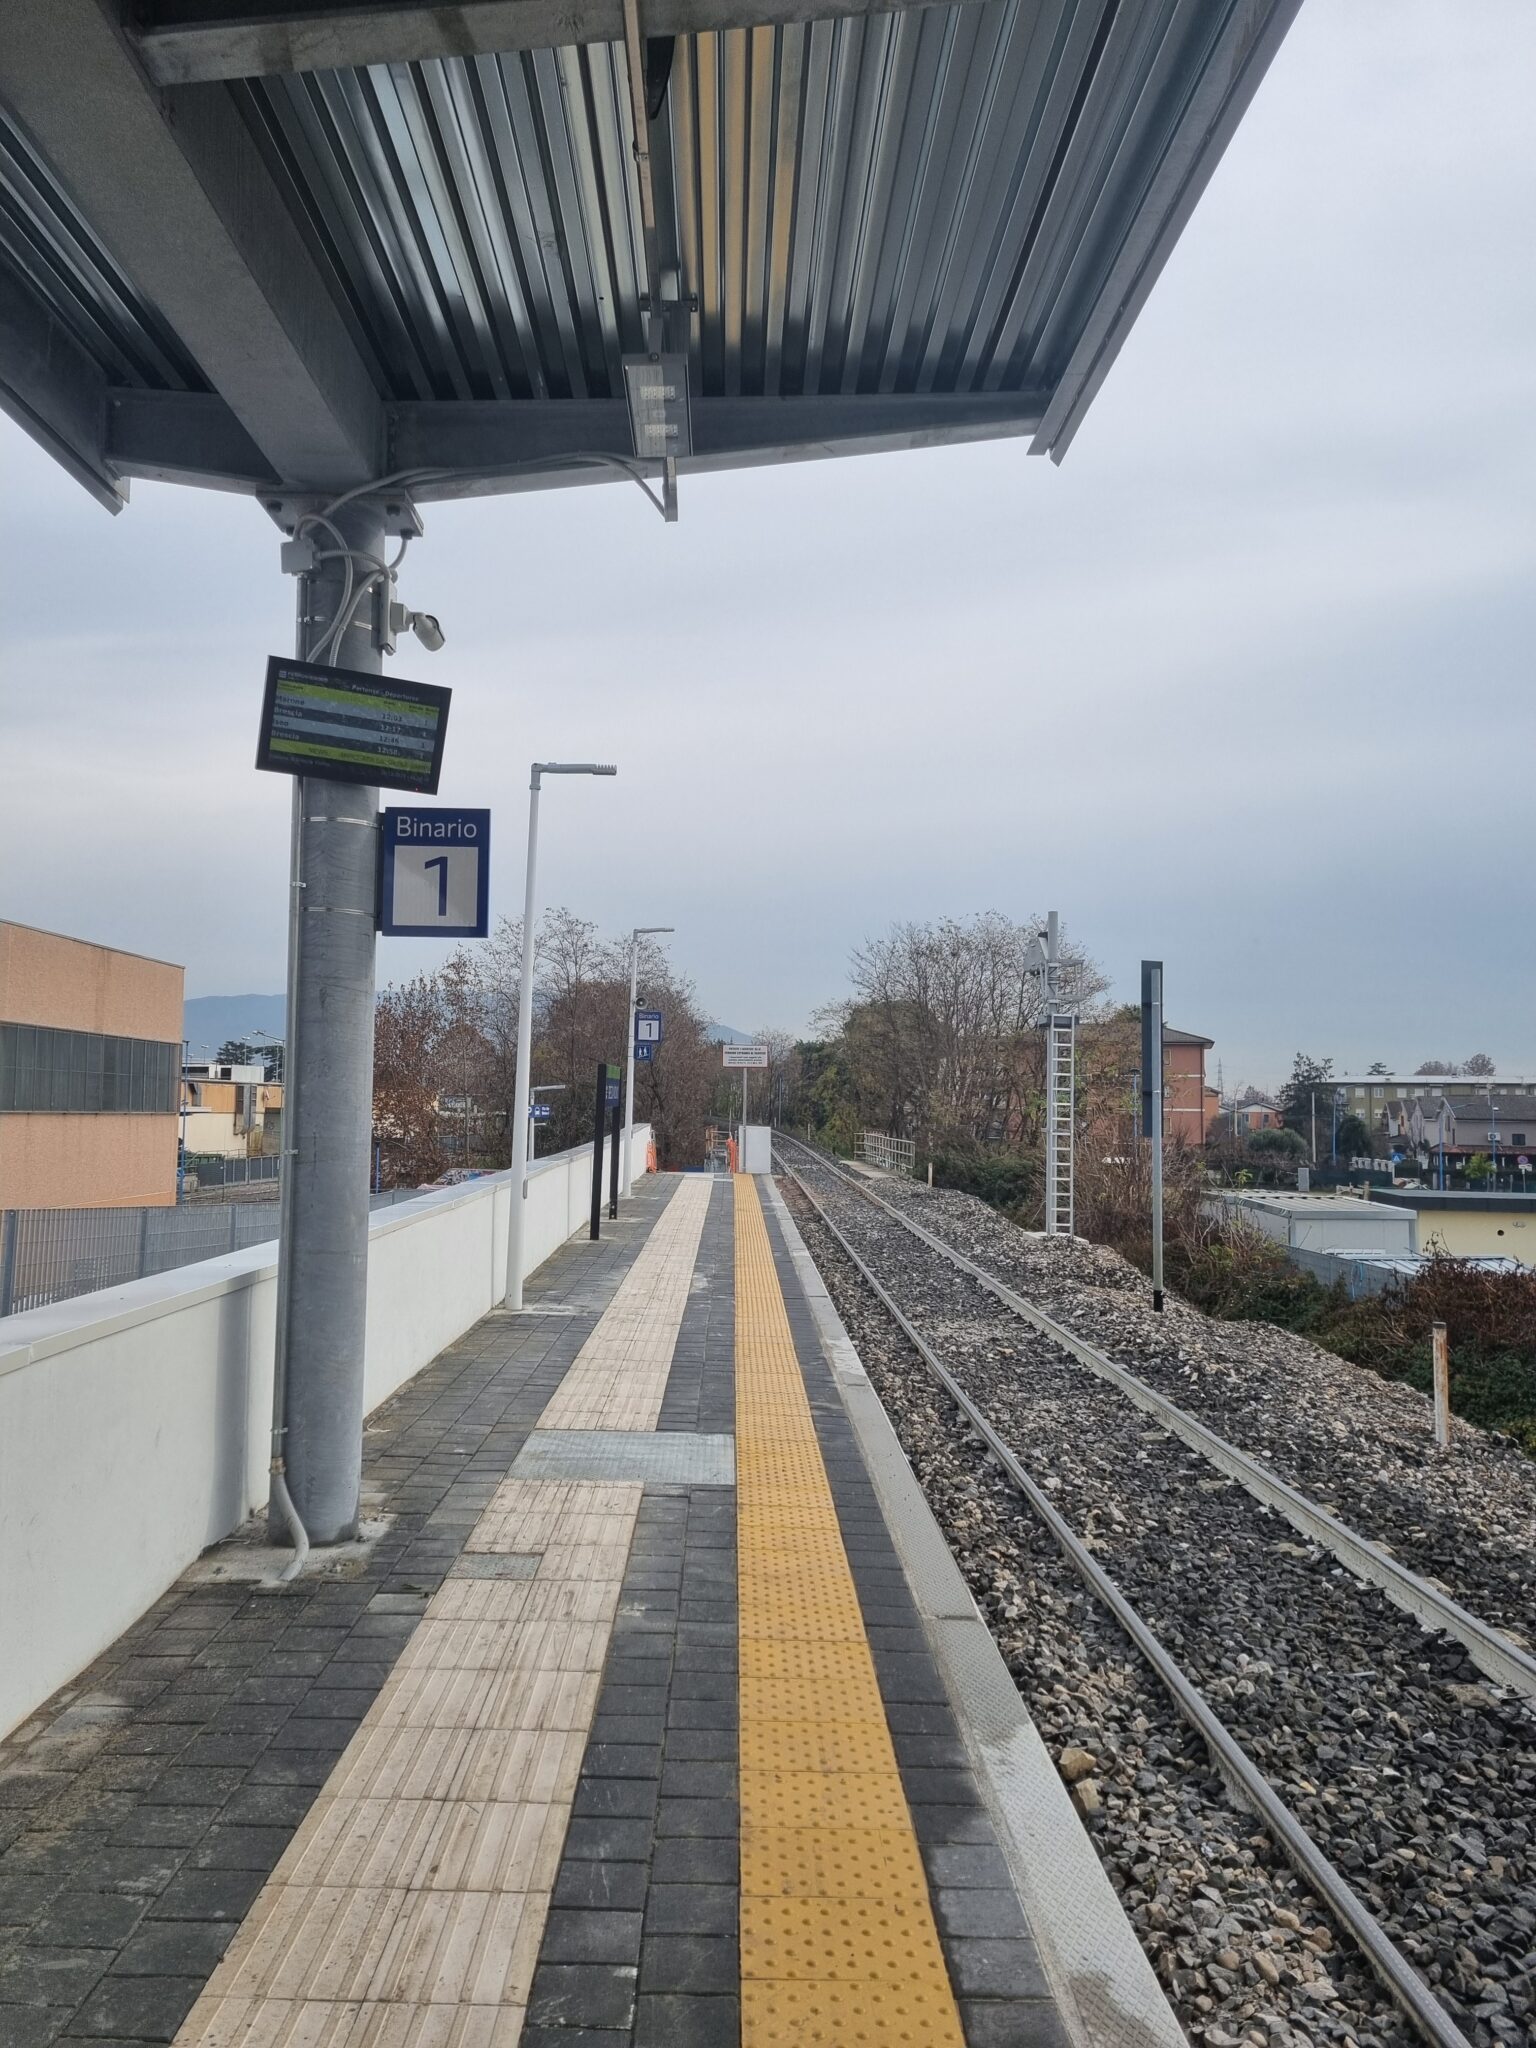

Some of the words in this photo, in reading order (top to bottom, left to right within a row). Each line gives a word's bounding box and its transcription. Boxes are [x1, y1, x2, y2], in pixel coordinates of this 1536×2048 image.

[274, 706, 303, 717] Brescia
[271, 729, 300, 740] Brescia
[396, 816, 477, 839] Binario
[424, 856, 448, 916] 1
[638, 1012, 659, 1020] Binario
[646, 1022, 652, 1038] 1
